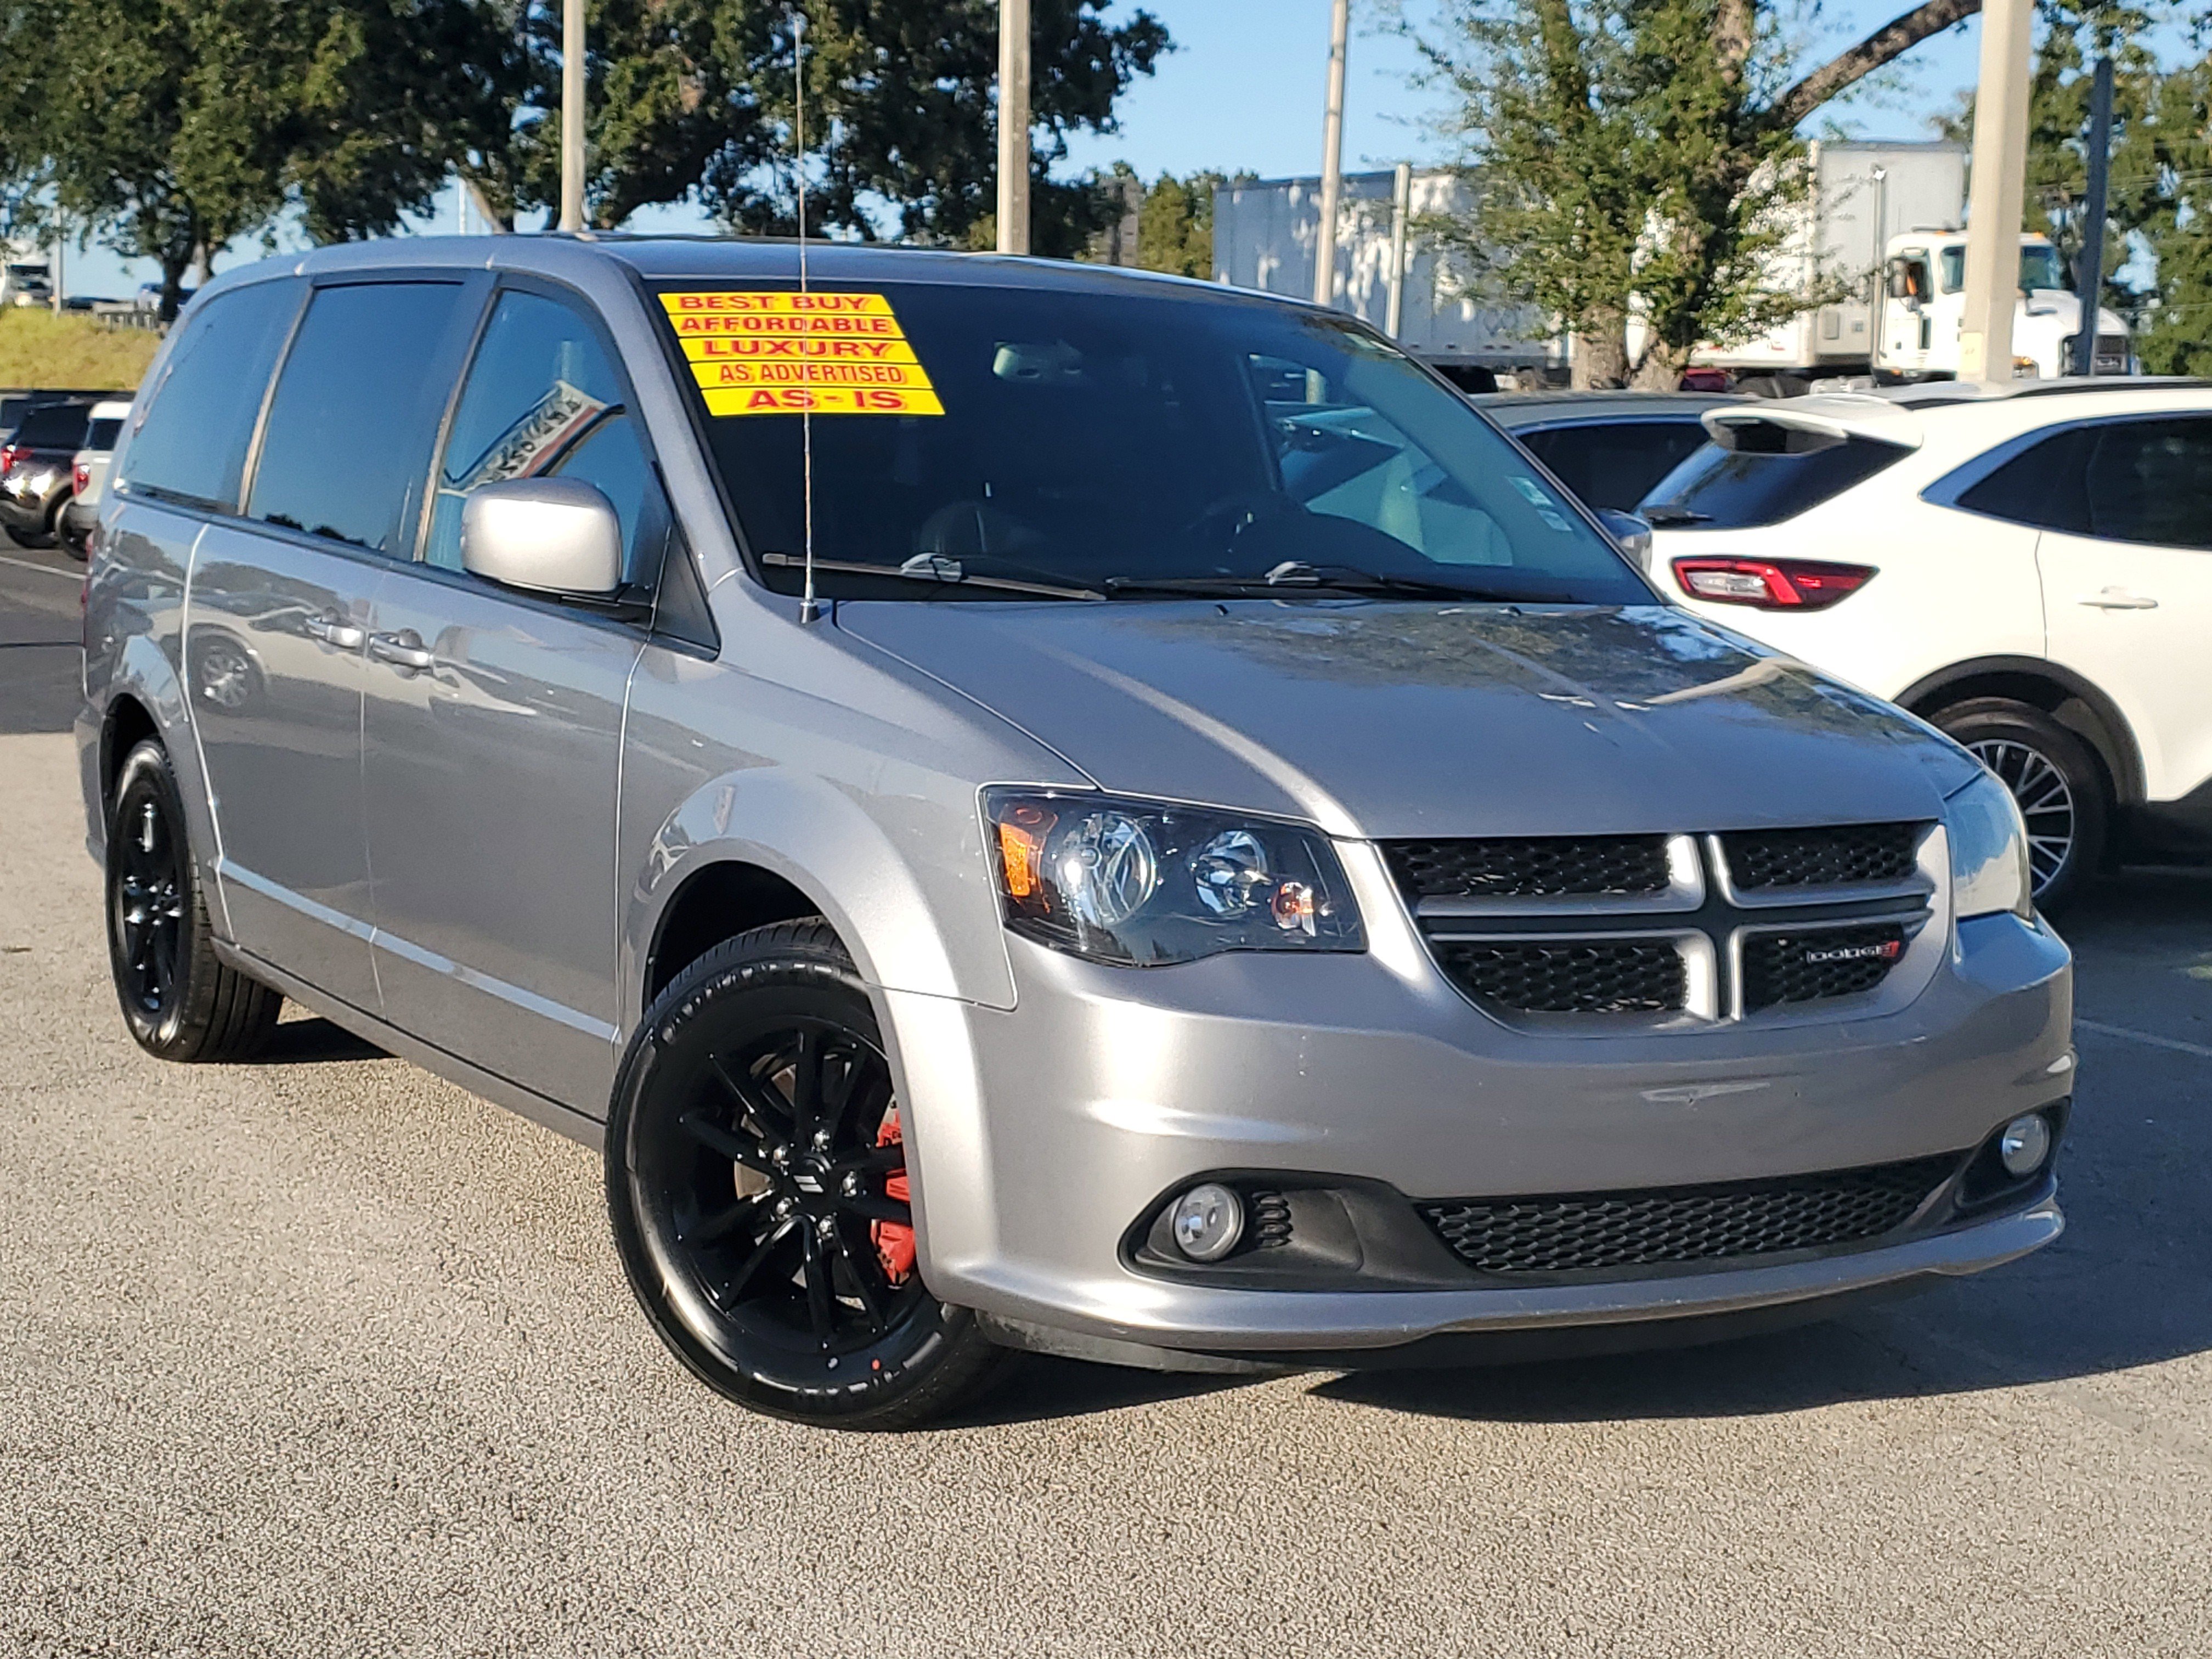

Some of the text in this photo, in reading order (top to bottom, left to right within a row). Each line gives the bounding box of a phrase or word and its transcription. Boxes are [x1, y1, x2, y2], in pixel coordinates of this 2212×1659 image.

[679, 296, 866, 310] BEST BUY
[680, 317, 889, 332] AFFORDABLE
[704, 340, 890, 357] LUXURY
[720, 364, 902, 382] AS ADVERTISED
[1807, 945, 1891, 963] DODGE
